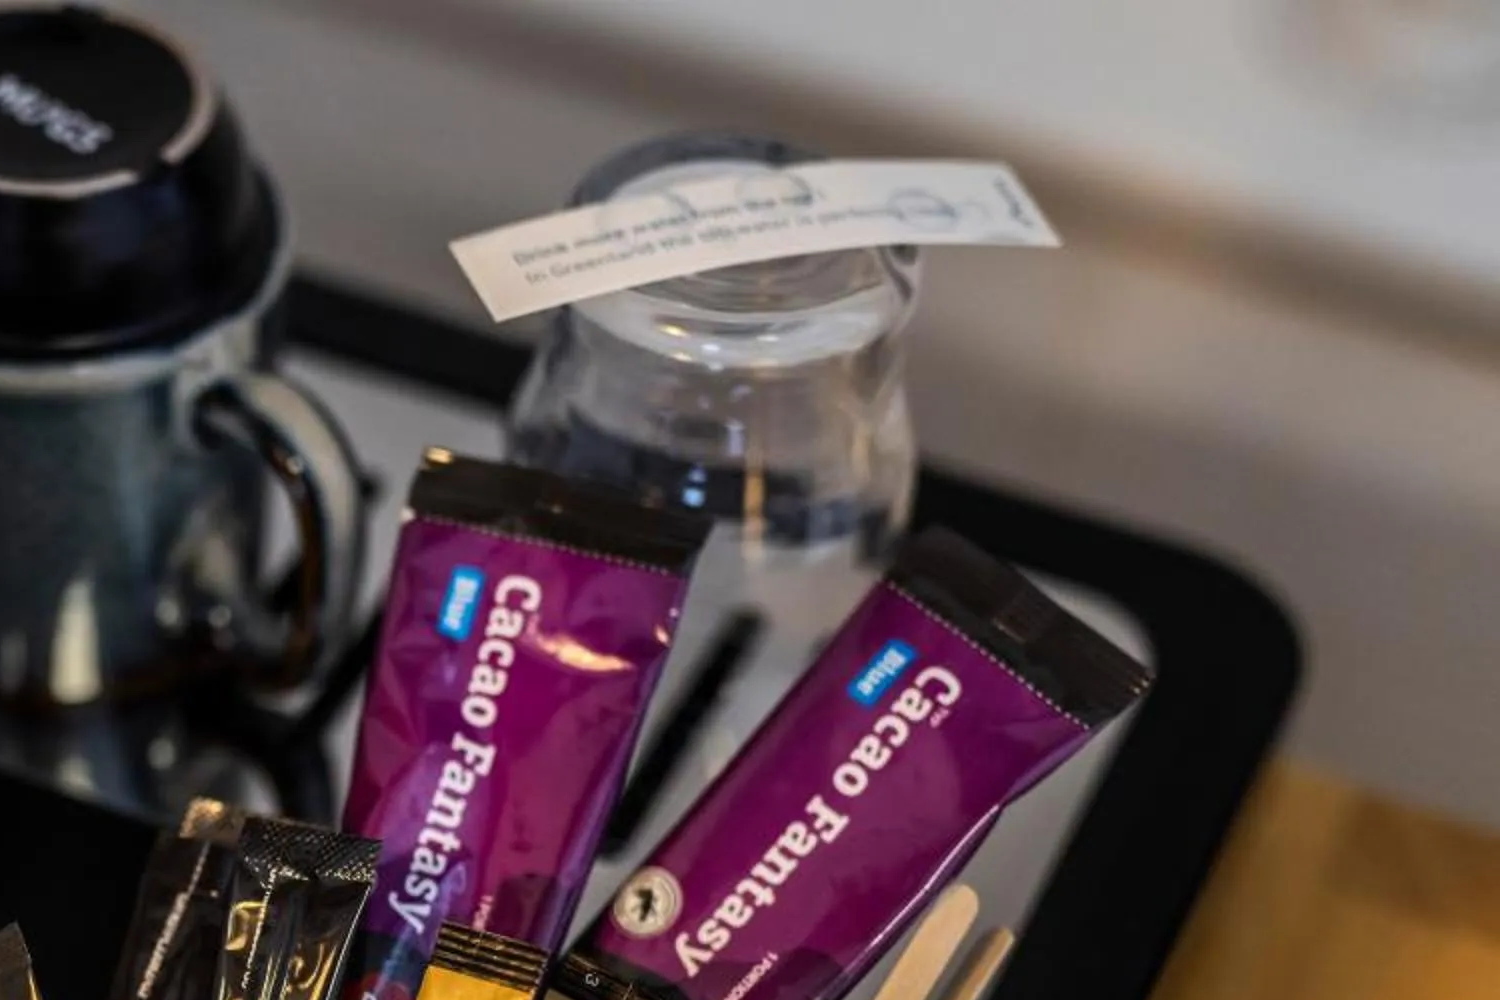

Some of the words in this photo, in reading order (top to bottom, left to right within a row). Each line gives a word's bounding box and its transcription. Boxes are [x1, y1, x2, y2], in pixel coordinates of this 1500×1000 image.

[460, 574, 542, 728] Cacao
[857, 648, 906, 695] Blue
[831, 665, 963, 799] Cacao
[387, 732, 496, 936] Fantasy
[673, 796, 850, 978] Fantasy
